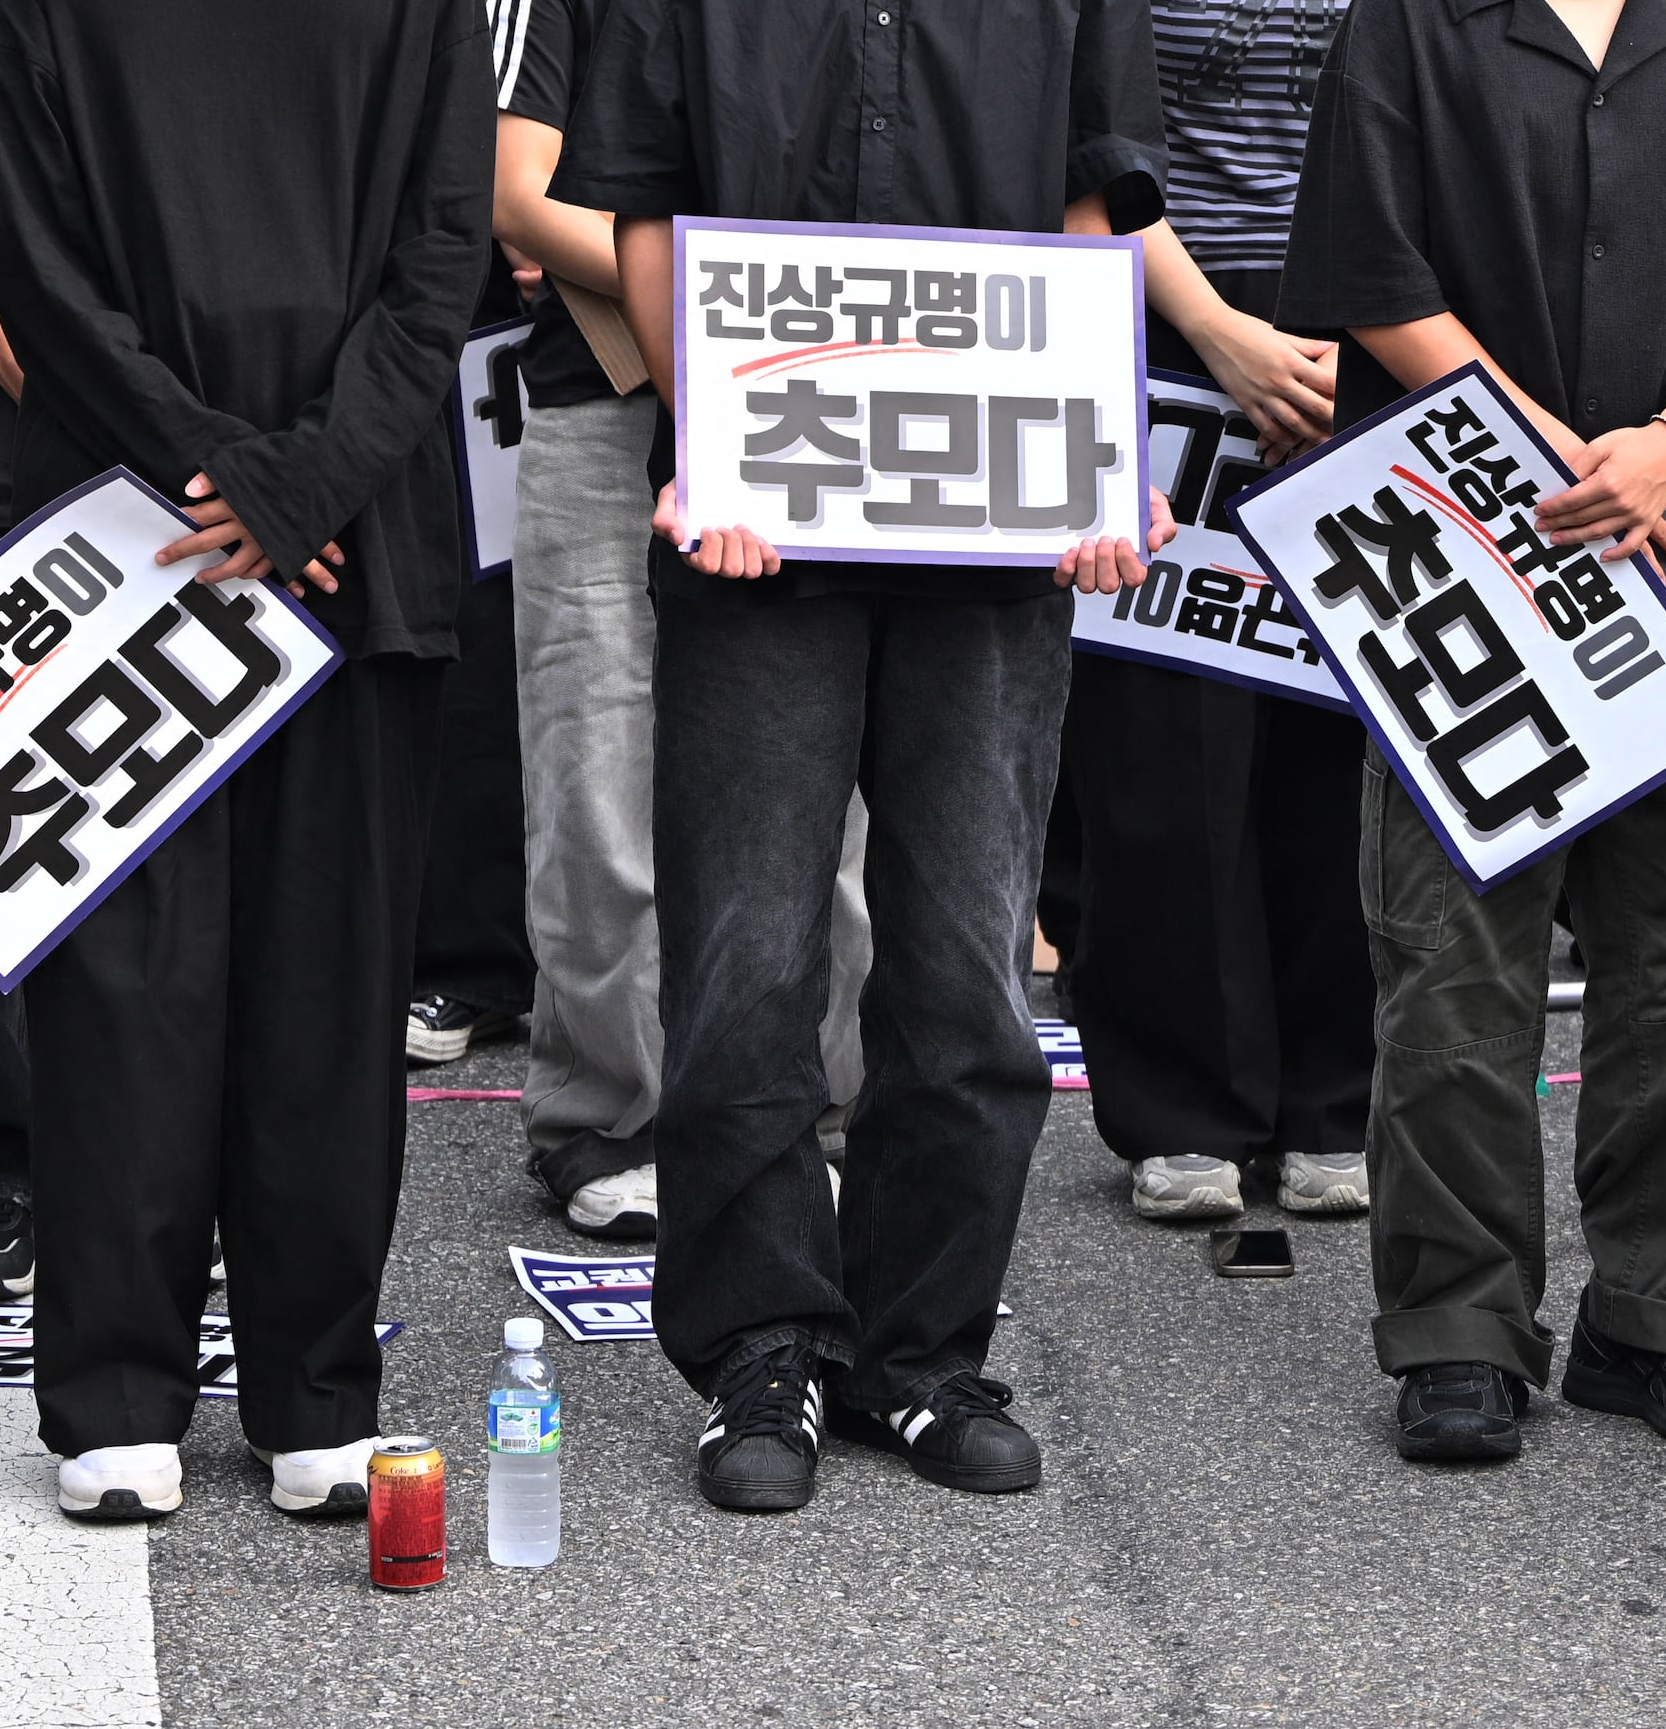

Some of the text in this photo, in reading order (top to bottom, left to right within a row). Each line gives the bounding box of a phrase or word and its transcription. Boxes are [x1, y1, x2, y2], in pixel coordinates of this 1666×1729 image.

[699, 260, 1047, 353] 진상규명이
[739, 380, 1123, 536] 추모다
[1404, 395, 1665, 701] 진상규명이
[1311, 485, 1592, 838] 추모다
